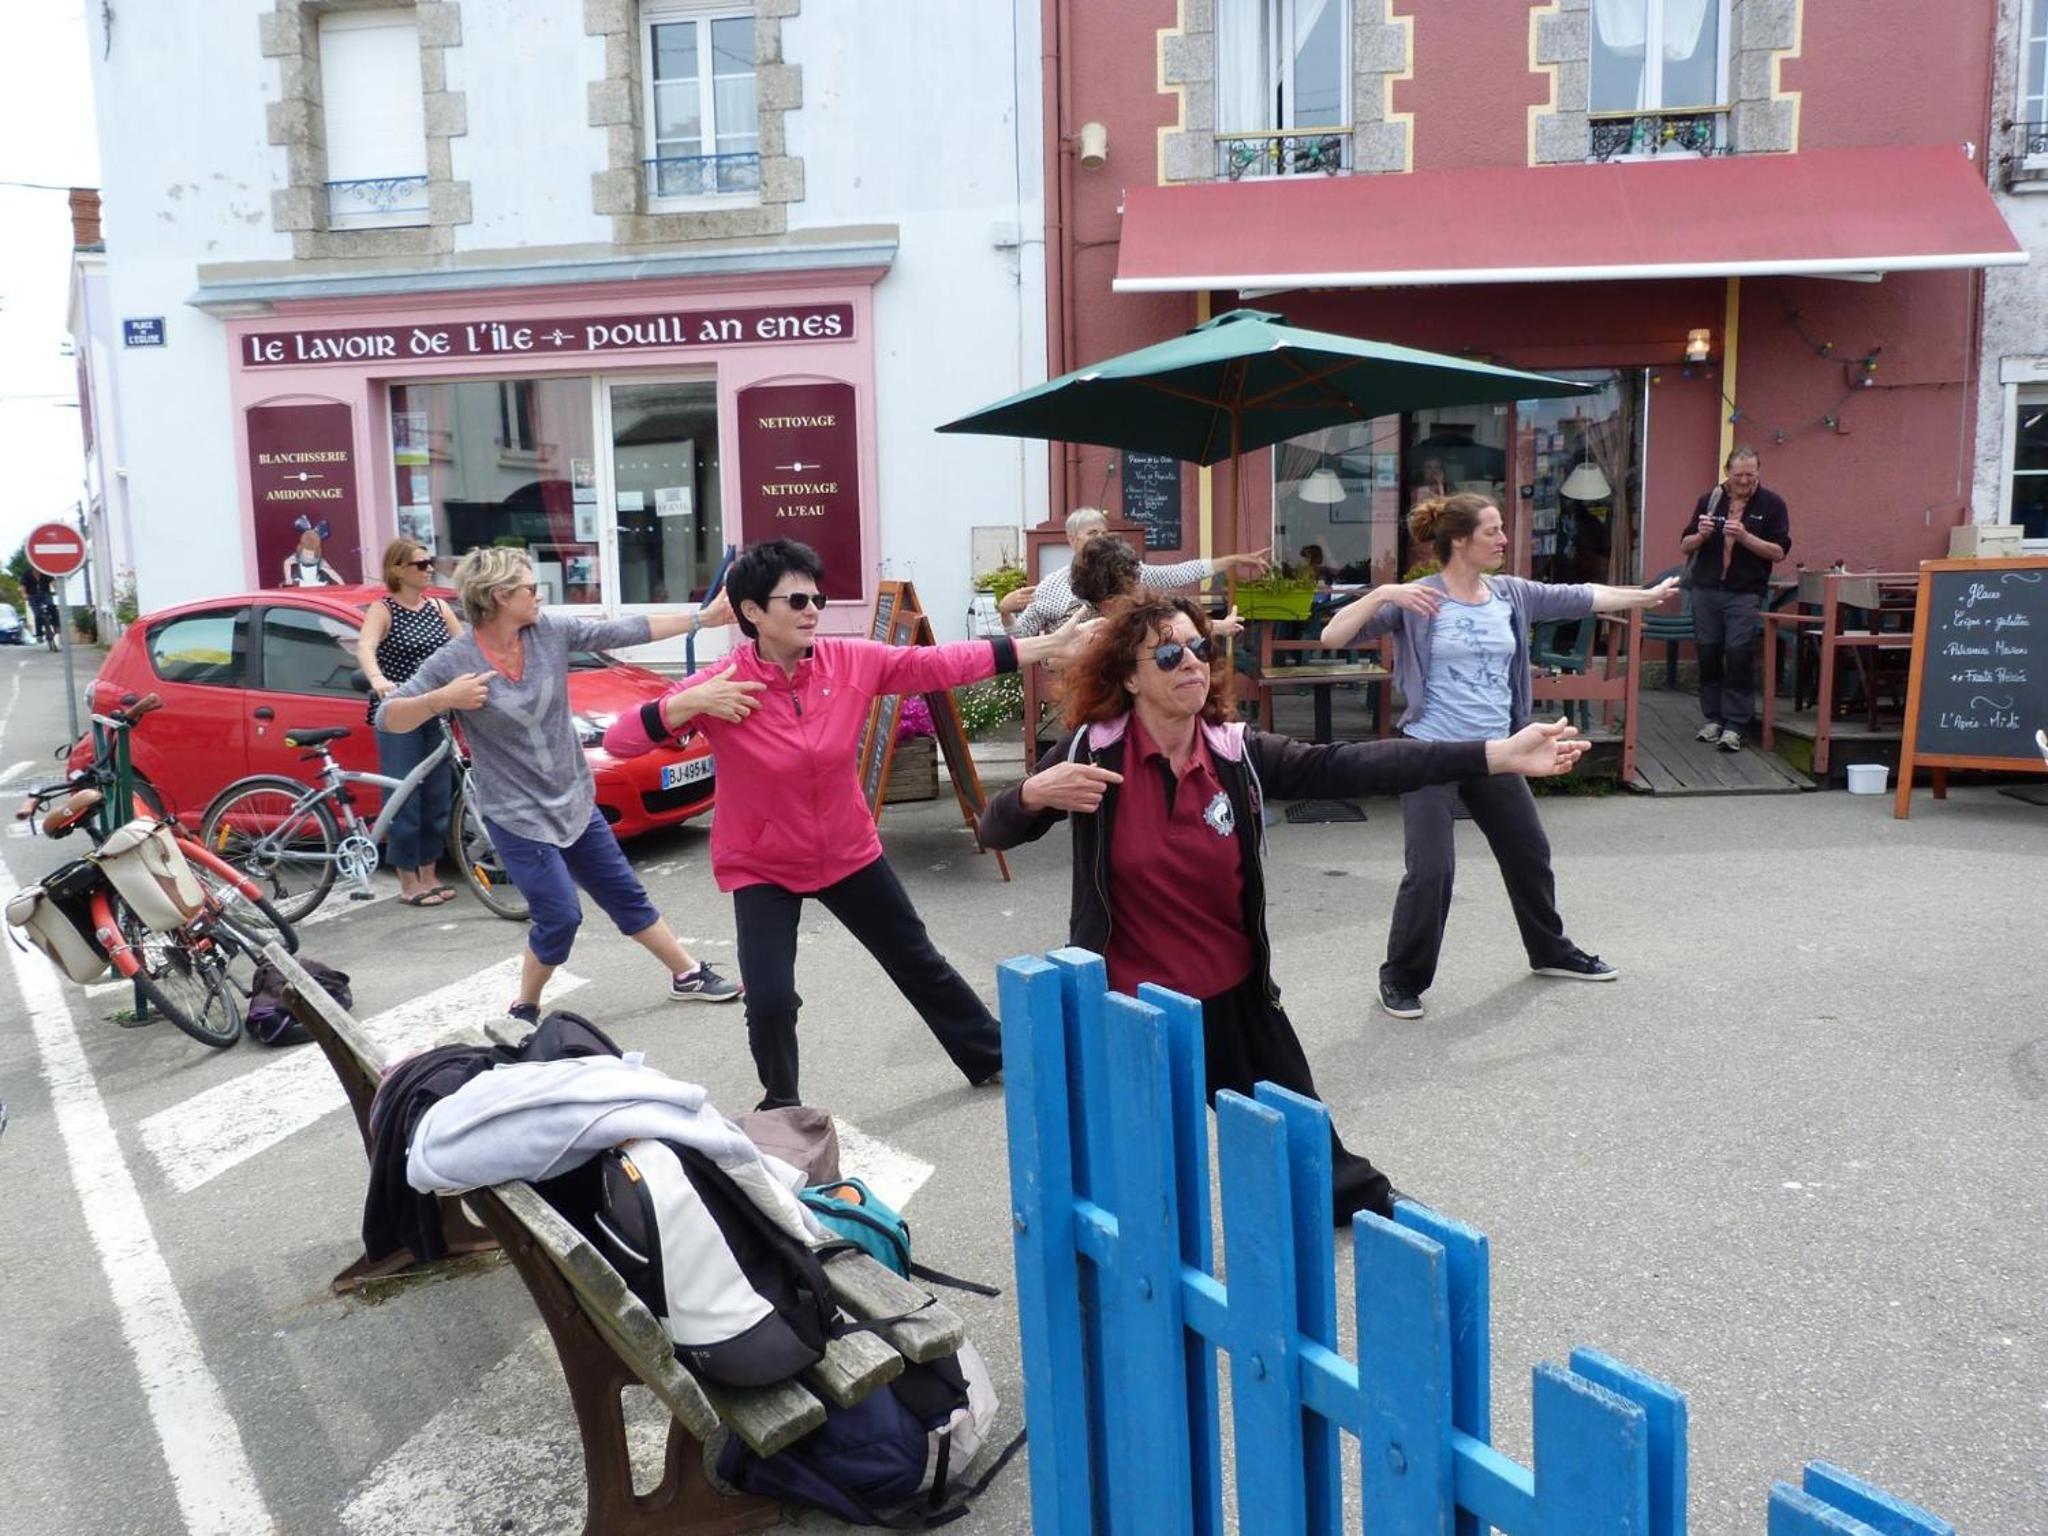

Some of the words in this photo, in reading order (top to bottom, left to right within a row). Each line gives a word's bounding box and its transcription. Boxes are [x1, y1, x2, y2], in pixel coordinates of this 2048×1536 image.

[759, 414, 837, 429] NETTOYAGE
[258, 451, 348, 465] BLANCHISSERIE
[265, 488, 345, 501] AMIDONNAGE
[761, 482, 839, 496] NETTOYAGE
[775, 506, 786, 518] A
[788, 505, 825, 517] L'EAU
